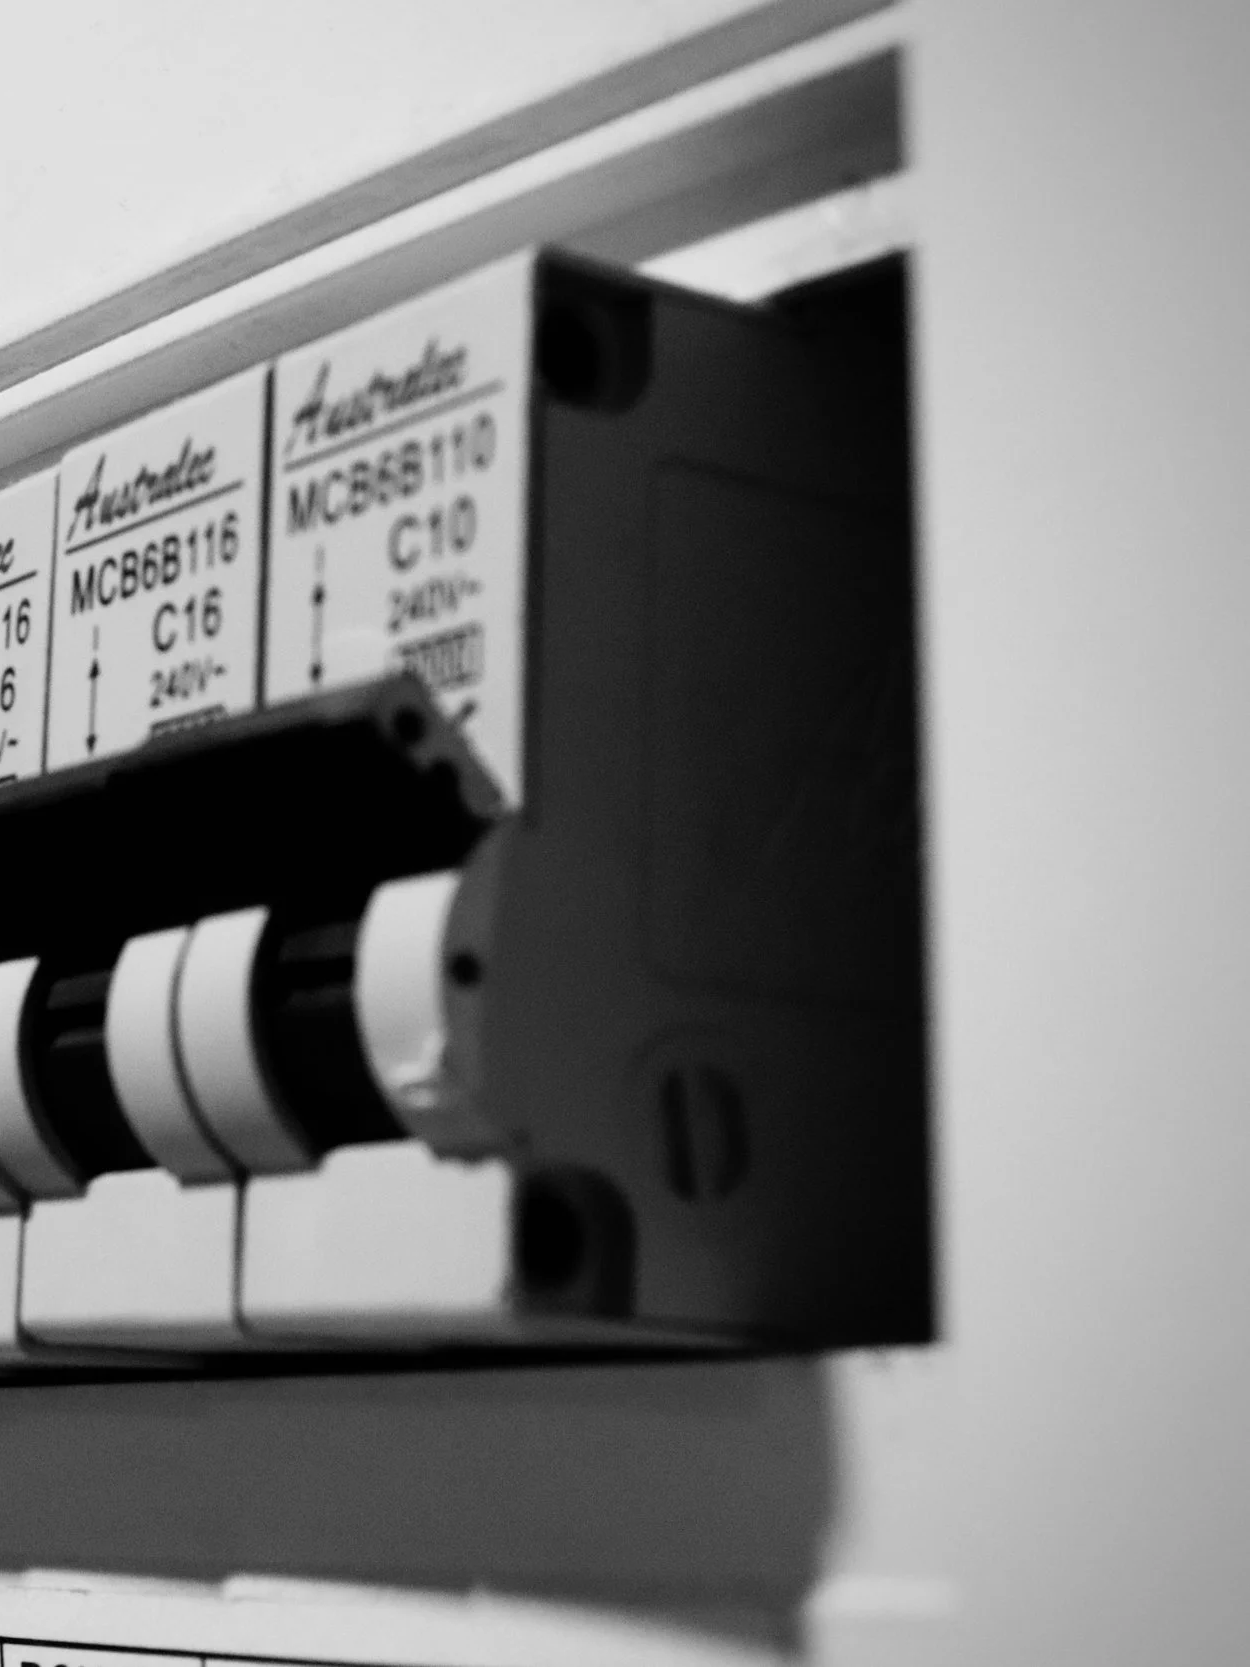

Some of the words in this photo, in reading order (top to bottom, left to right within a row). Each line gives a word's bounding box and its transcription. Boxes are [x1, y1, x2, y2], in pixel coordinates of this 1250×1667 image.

[66, 436, 216, 542] Australec
[286, 410, 498, 537] MCB6B110
[70, 509, 240, 616] MCB6B116
[387, 494, 477, 574] C10
[153, 586, 222, 654] C16
